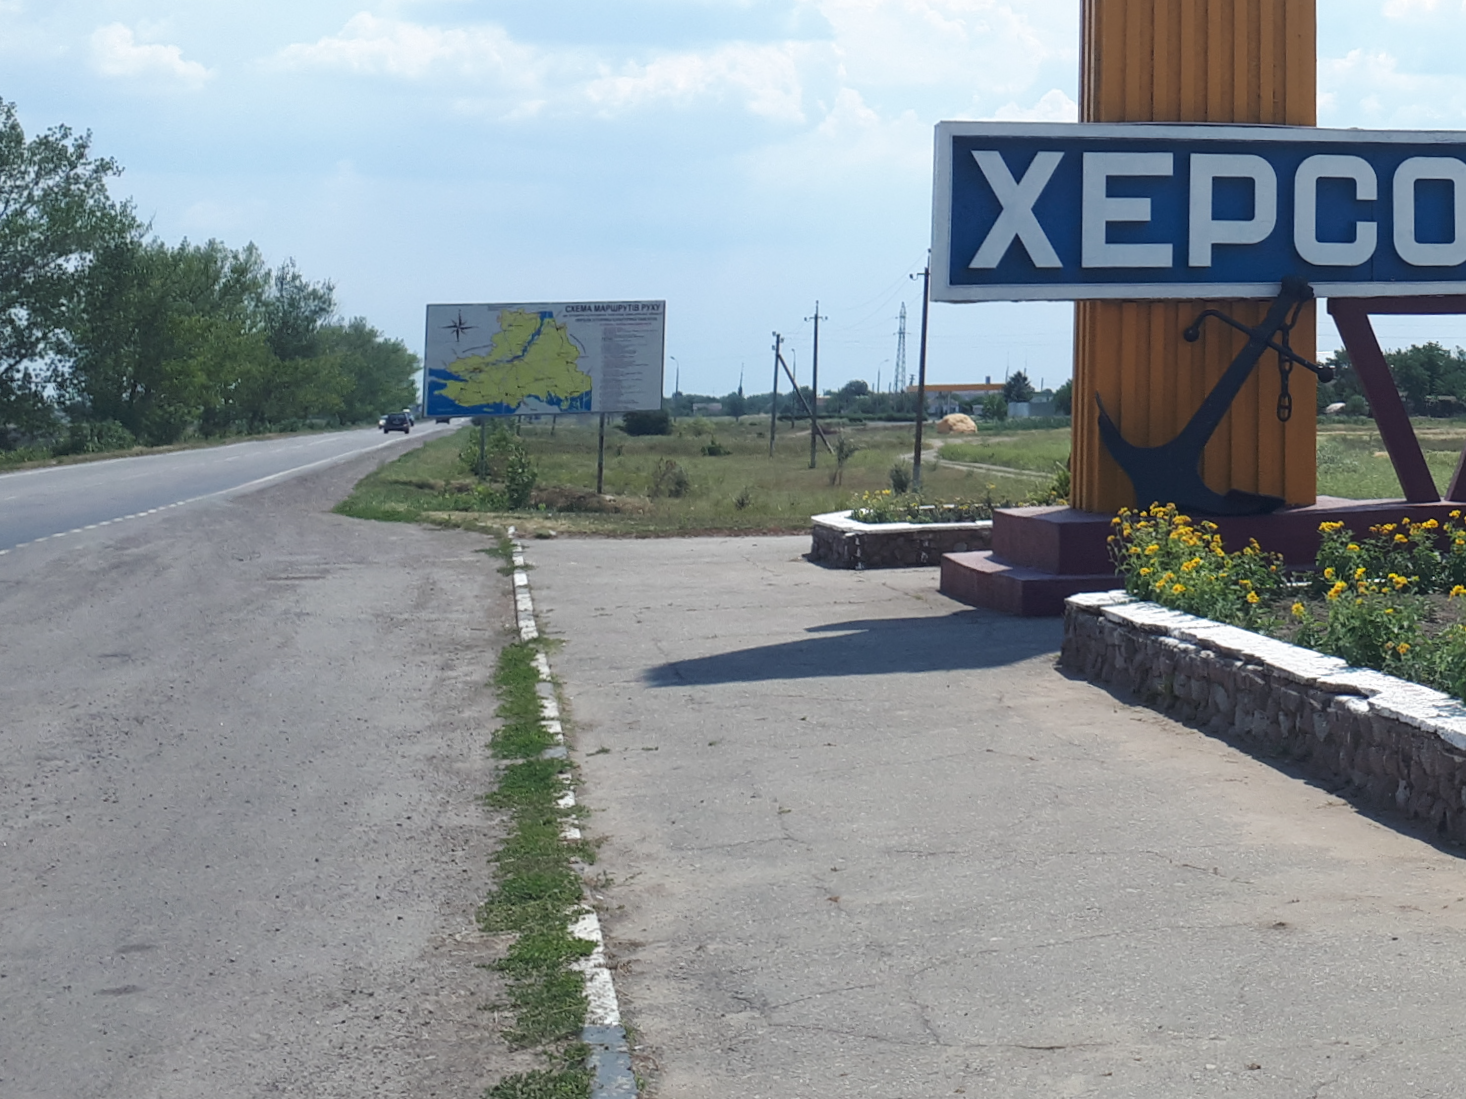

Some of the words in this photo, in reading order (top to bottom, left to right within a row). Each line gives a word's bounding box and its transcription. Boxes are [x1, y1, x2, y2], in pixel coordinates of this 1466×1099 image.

[565, 304, 592, 313] СХЕМА
[594, 303, 639, 313] МАРШРУТІВ
[641, 303, 661, 312] РУХУ
